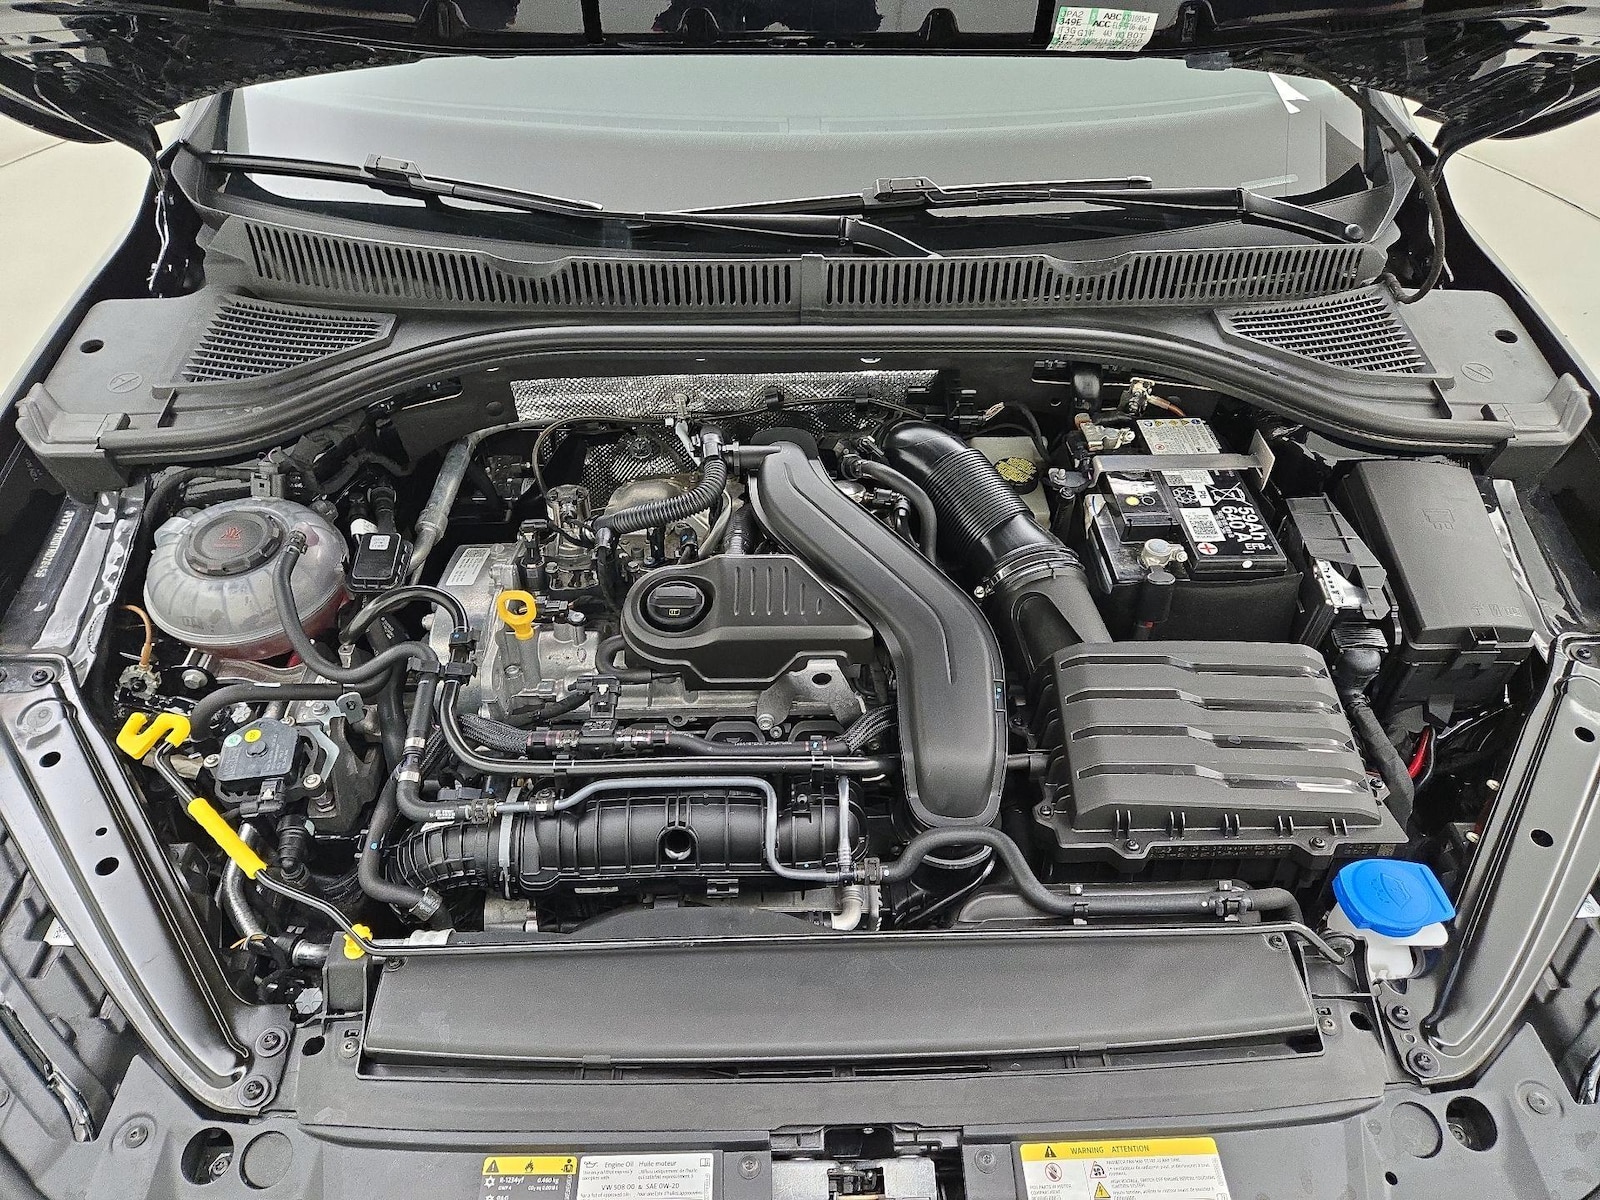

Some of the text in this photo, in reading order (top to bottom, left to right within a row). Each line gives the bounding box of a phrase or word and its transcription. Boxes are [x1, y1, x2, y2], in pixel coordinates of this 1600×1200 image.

[1103, 12, 1122, 20] ABC
[1091, 20, 1111, 28] ACC
[1198, 490, 1207, 499] Pb
[1221, 506, 1246, 529] 640
[1238, 506, 1268, 541] 59Ah
[1244, 542, 1273, 550] EFB+
[1069, 1145, 1150, 1154] WARNING ATTENTION
[604, 1161, 624, 1169] Engine
[613, 1183, 626, 1191] 508
